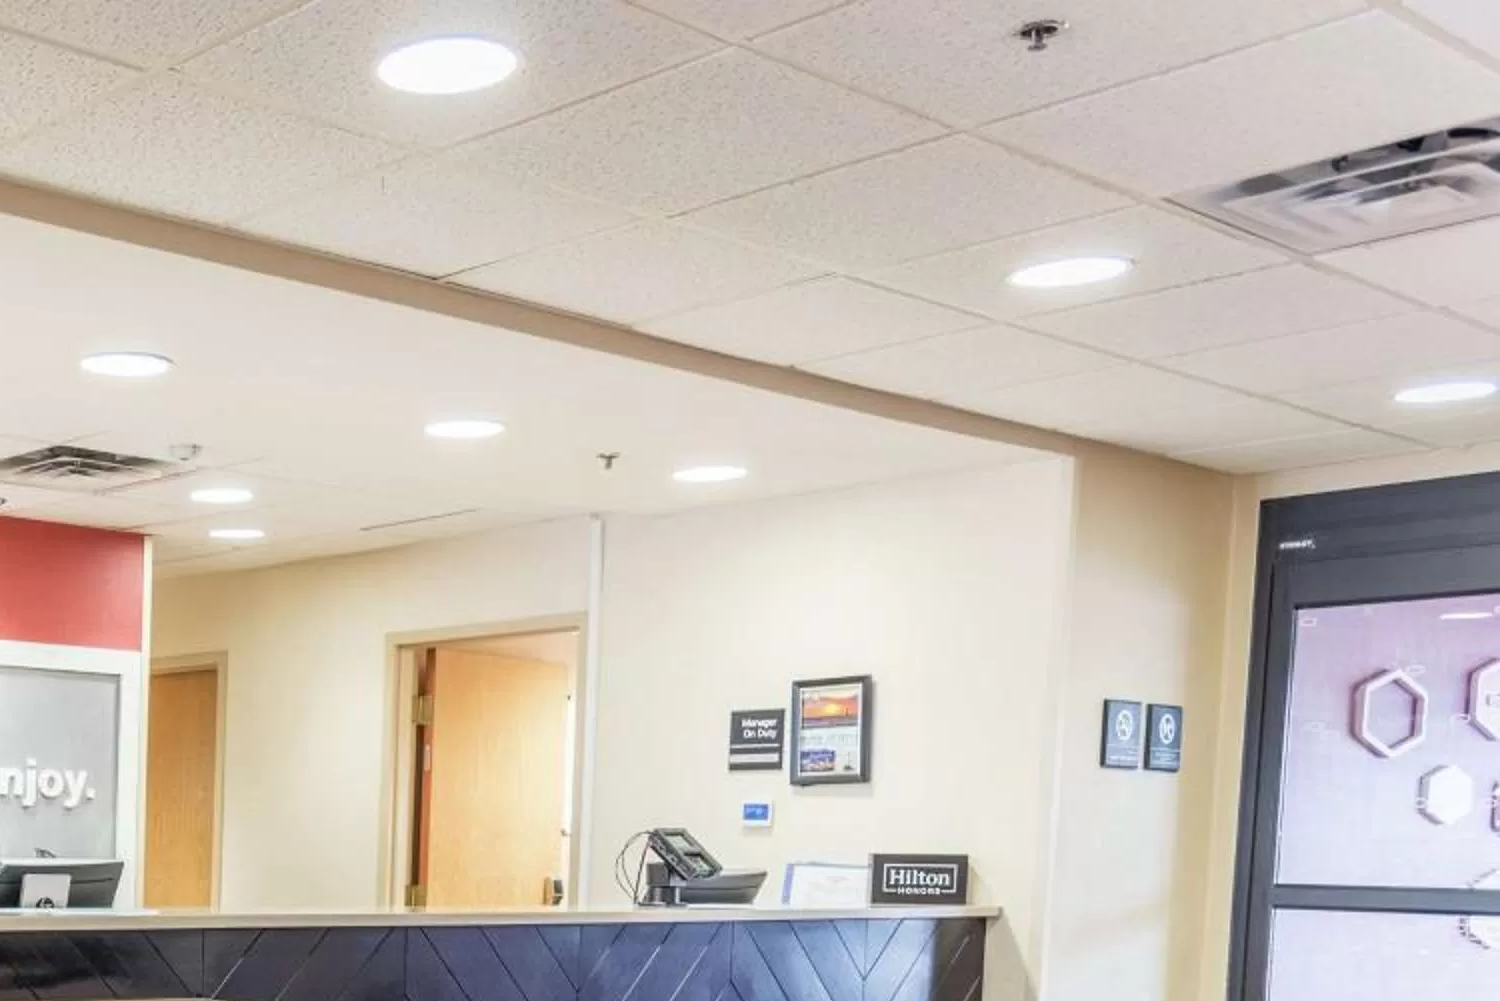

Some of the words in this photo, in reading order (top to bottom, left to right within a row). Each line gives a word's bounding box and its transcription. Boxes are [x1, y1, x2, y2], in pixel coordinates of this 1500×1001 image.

[741, 718, 777, 729] Manager
[743, 729, 756, 738] On
[889, 868, 950, 886] Hilton
[897, 887, 941, 895] HONORS
